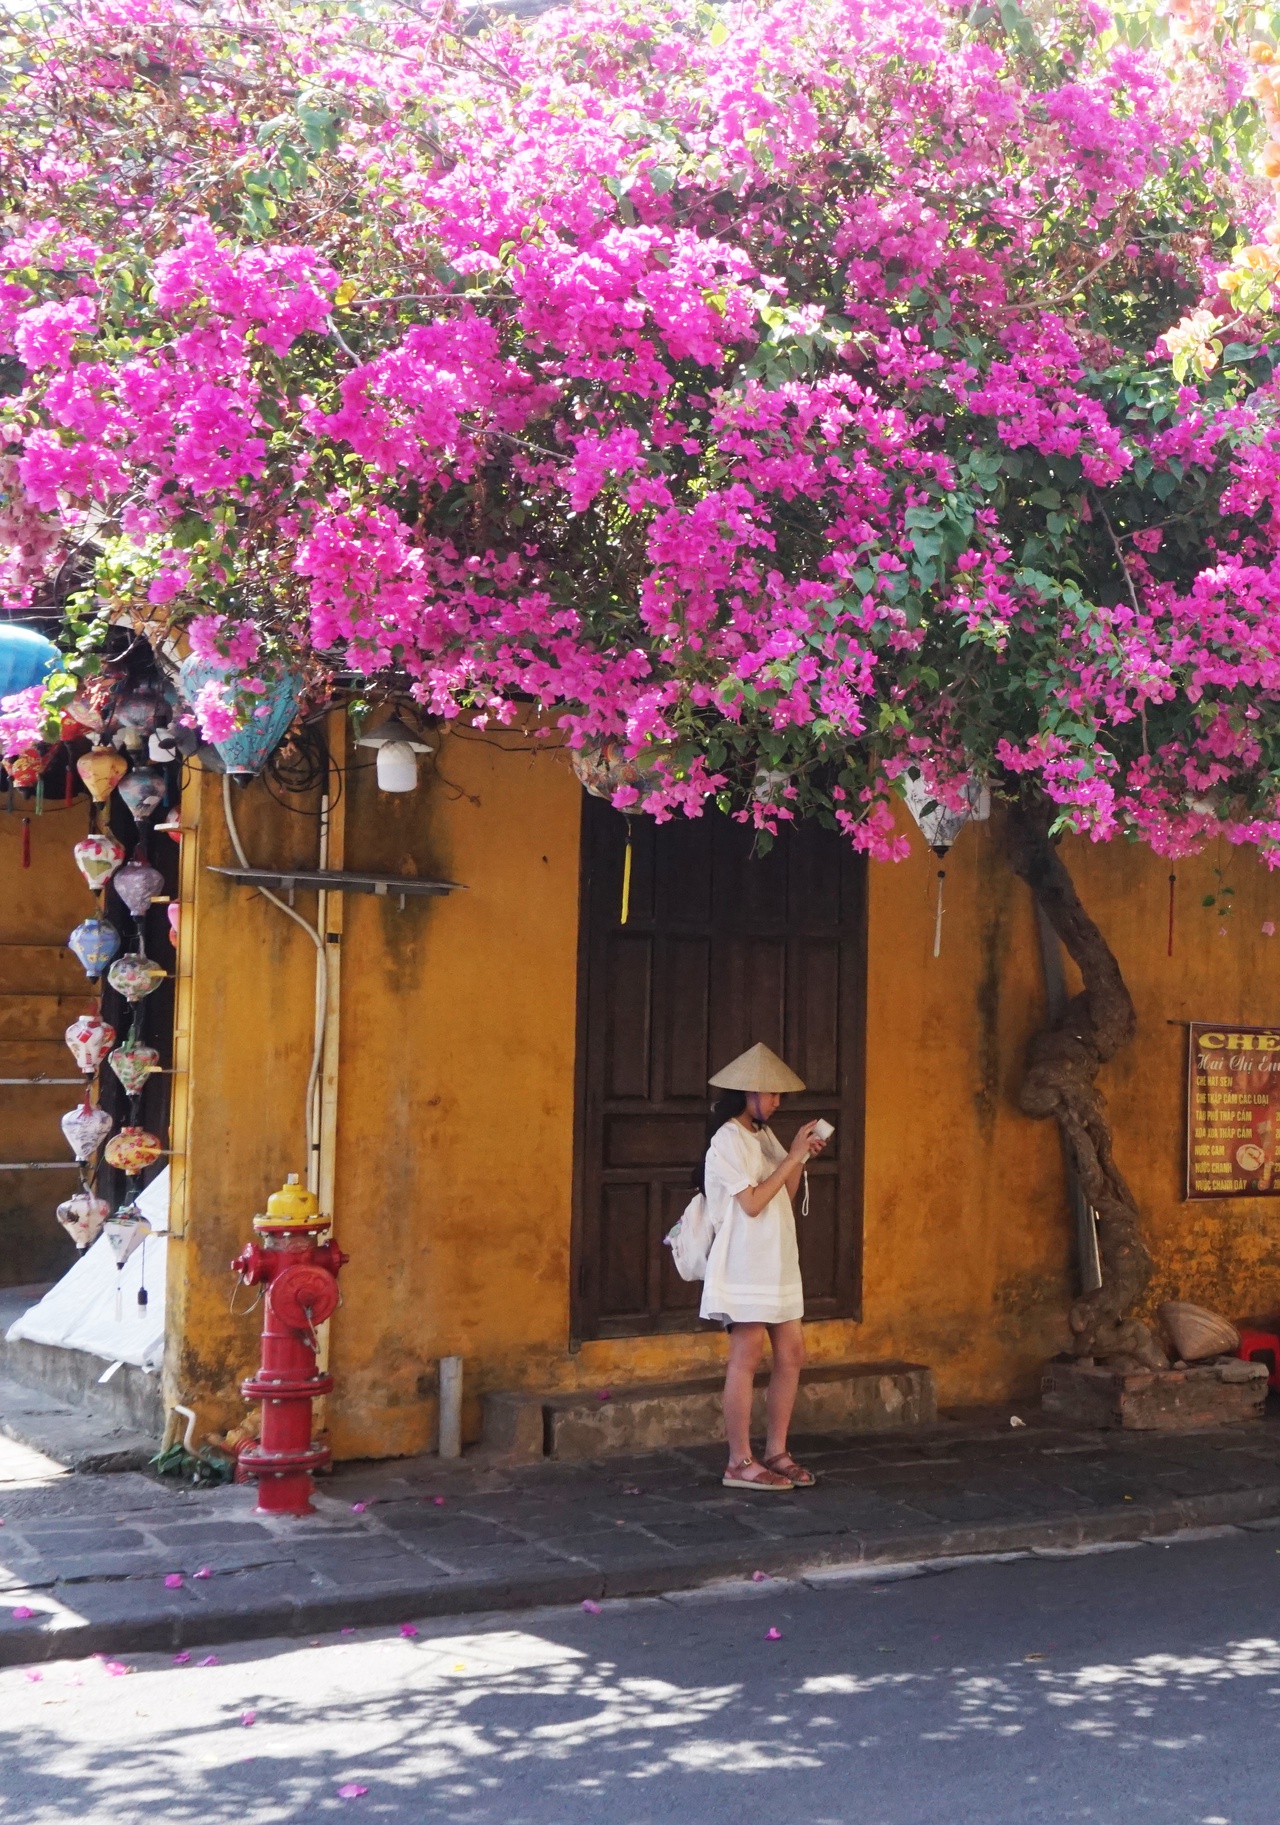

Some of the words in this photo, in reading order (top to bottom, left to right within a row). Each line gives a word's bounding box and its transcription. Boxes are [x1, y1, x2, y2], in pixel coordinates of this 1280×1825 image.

[1197, 1053, 1224, 1071] Hai
[1229, 1054, 1254, 1074] Chị
[1254, 1094, 1269, 1107] LOẠI
